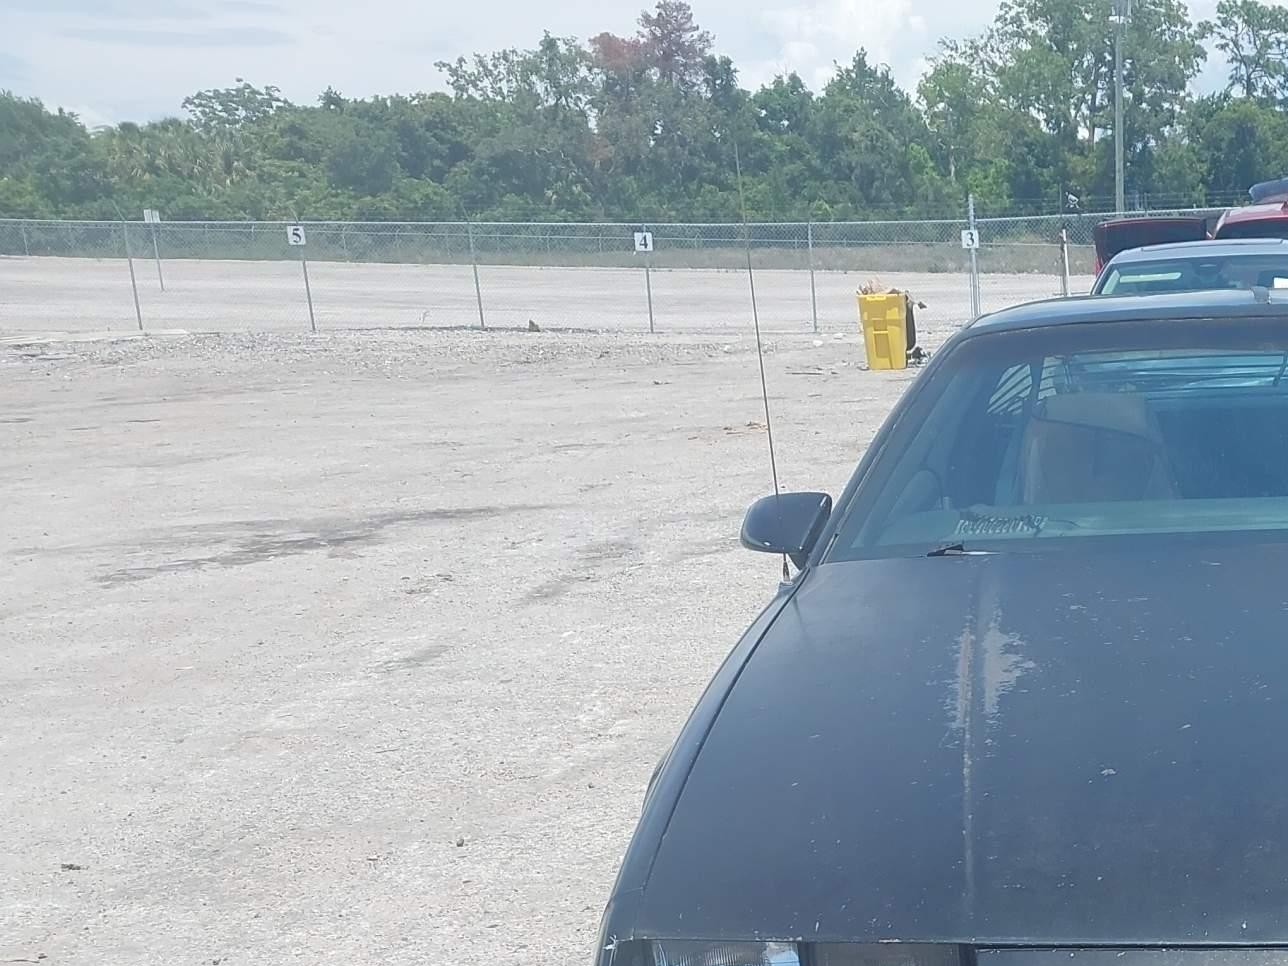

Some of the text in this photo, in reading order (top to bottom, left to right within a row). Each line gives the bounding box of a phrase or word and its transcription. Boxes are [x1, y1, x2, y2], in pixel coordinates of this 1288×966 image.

[292, 227, 302, 244] 5
[639, 234, 649, 249] 4
[966, 231, 975, 247] 3
